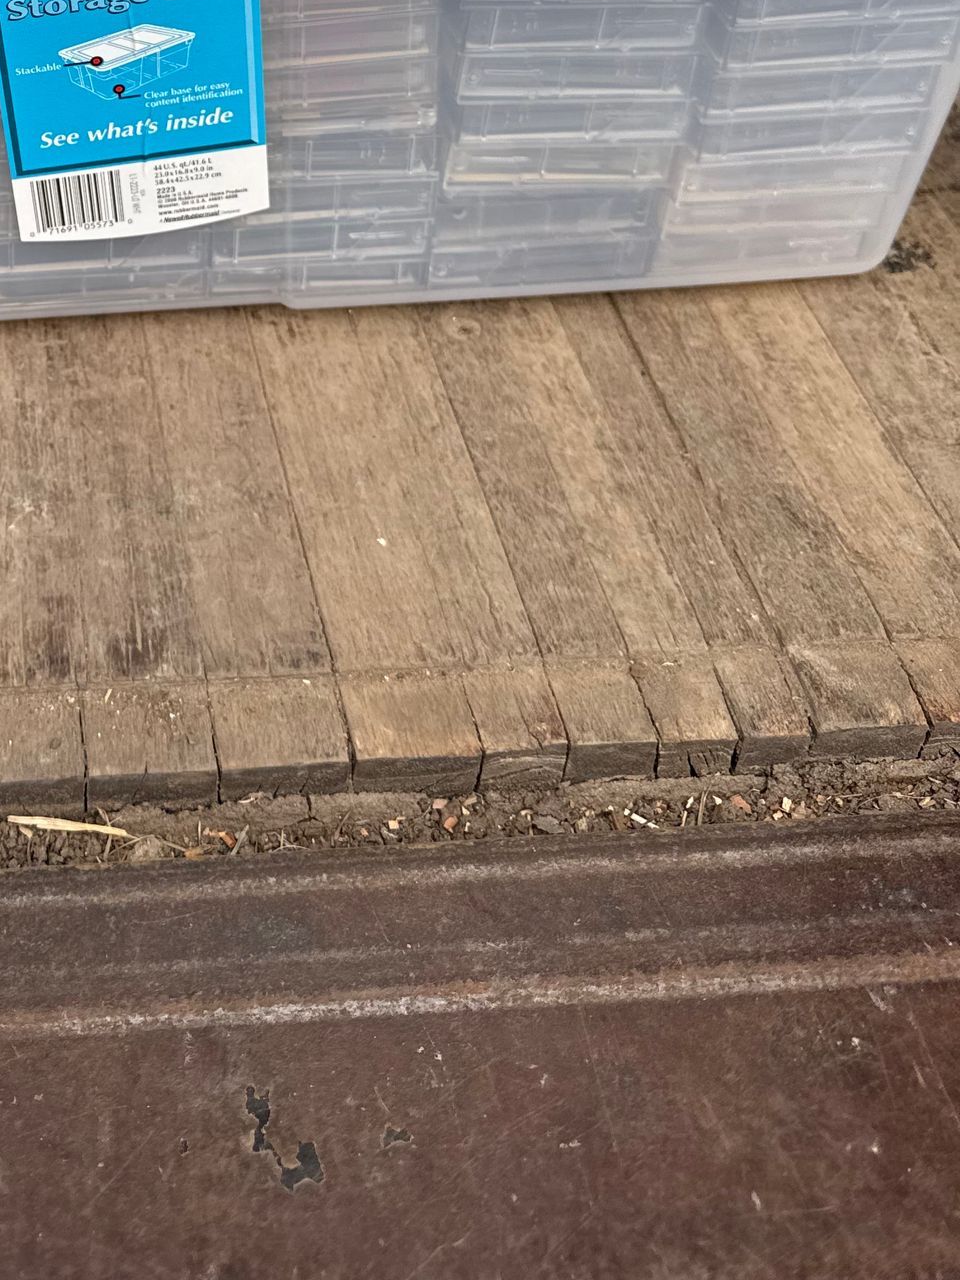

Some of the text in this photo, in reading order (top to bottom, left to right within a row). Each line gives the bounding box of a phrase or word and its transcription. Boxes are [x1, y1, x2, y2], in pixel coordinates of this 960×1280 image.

[15, 62, 62, 76] Stackable
[143, 82, 230, 100] Clear base for easy
[144, 88, 244, 109] content identification
[40, 106, 235, 149] See what's inside
[163, 162, 178, 170] U.S.
[156, 185, 176, 194] 2223
[49, 225, 78, 235] 71691
[84, 219, 114, 230] 05573
